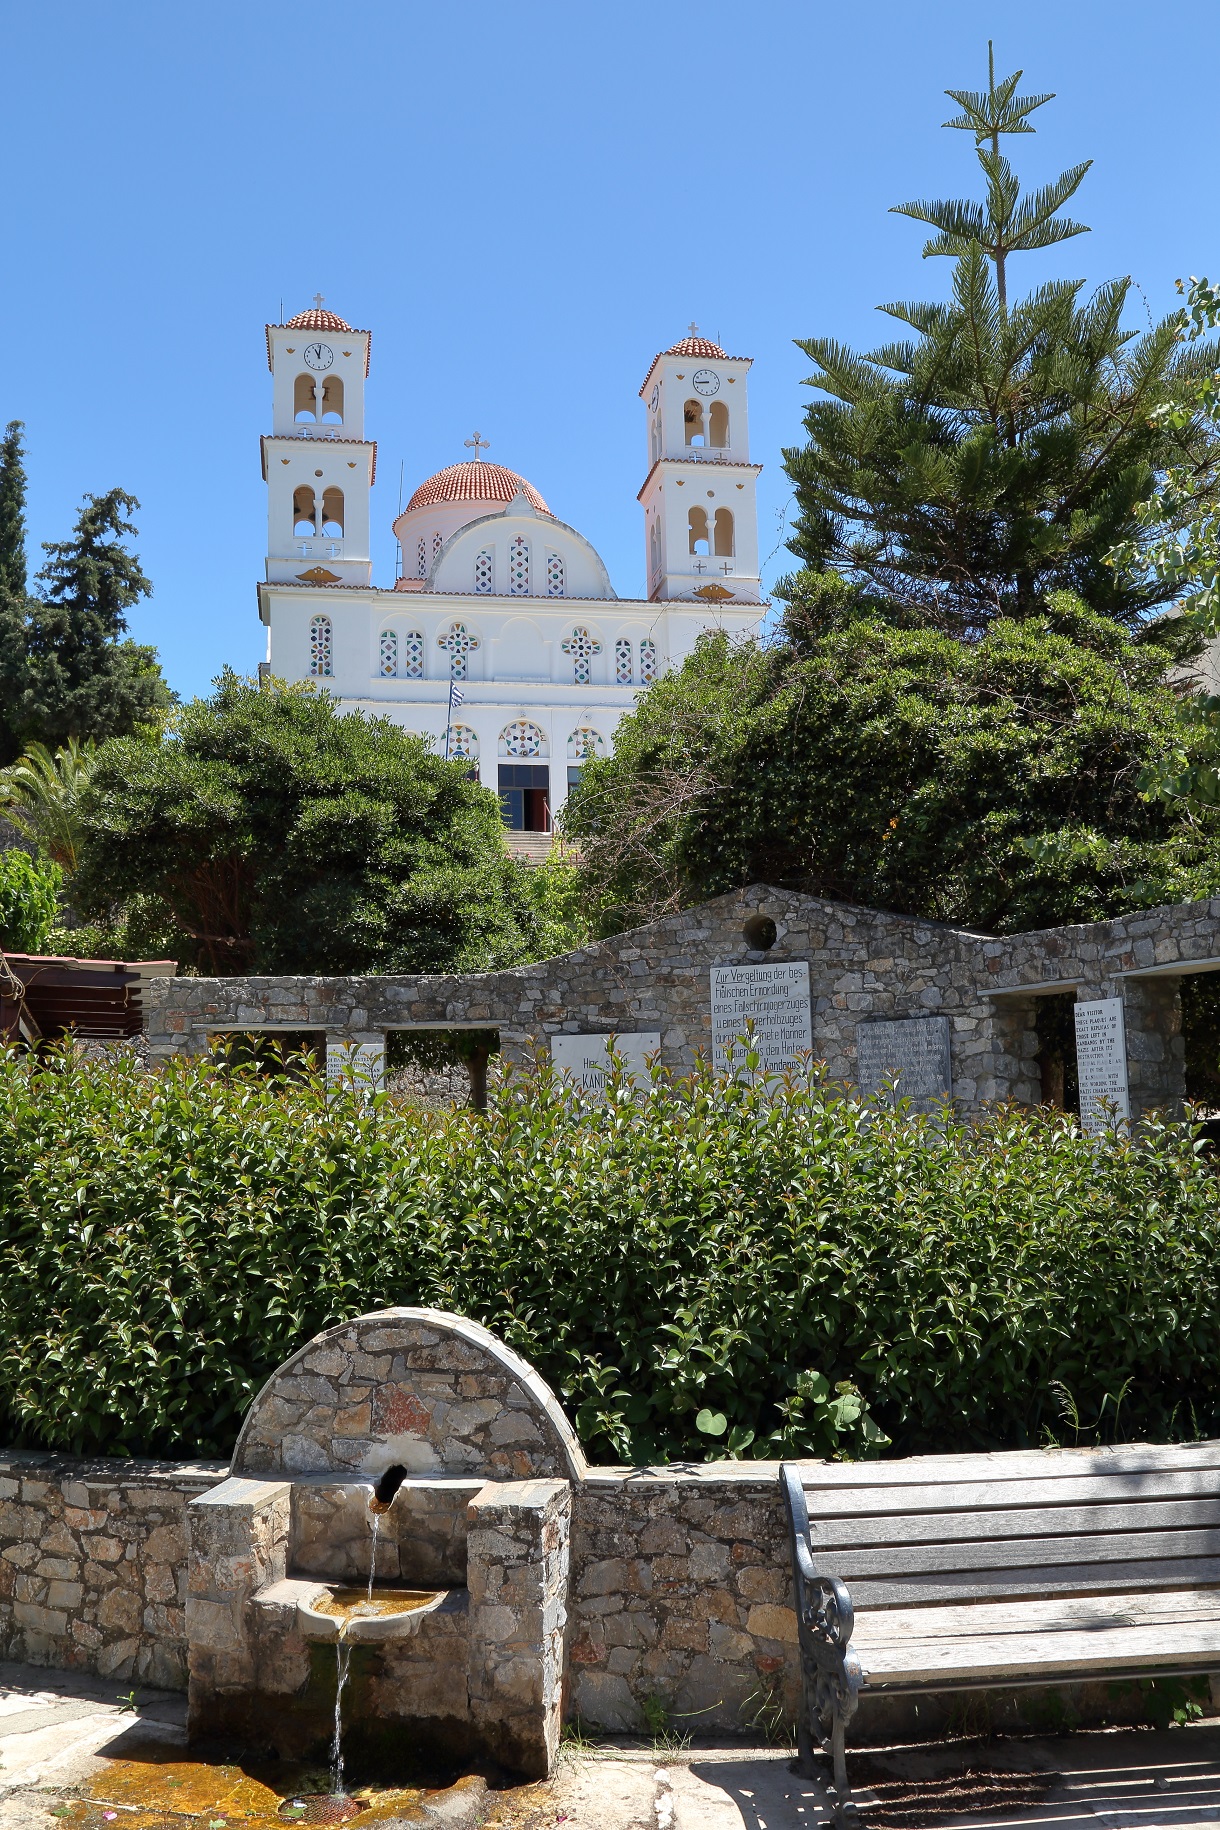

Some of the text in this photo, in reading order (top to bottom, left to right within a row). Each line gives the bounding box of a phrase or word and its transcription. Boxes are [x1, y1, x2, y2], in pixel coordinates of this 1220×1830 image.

[715, 969, 729, 984] Zur
[730, 968, 772, 984] Vergeltung
[773, 966, 786, 980] der
